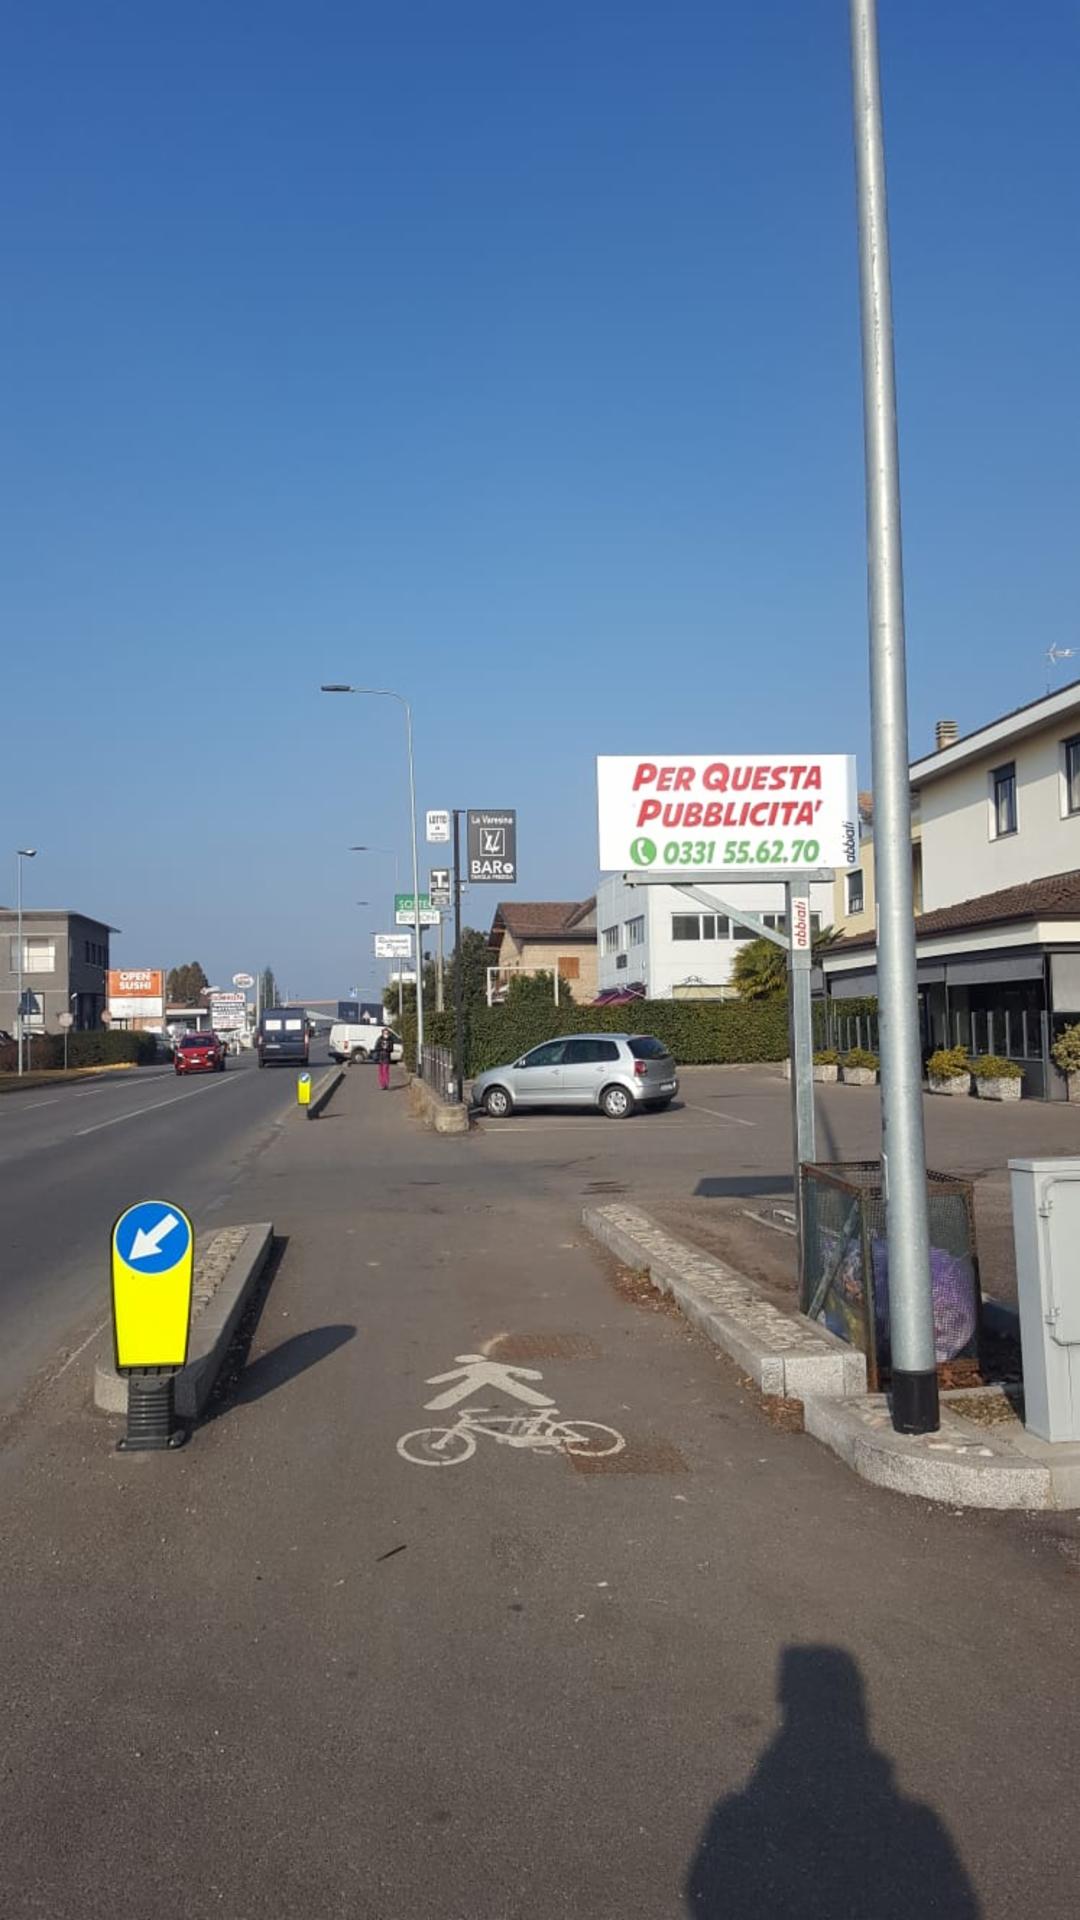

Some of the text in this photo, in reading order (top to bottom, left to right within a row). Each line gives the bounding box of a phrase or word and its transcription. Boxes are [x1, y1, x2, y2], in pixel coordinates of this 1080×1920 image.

[632, 762, 822, 792] PER QUESTA
[663, 839, 821, 864] 0331 55.62.70
[471, 860, 503, 874] BAR
[119, 972, 151, 981] OPEN
[119, 981, 152, 990] SUSHI
